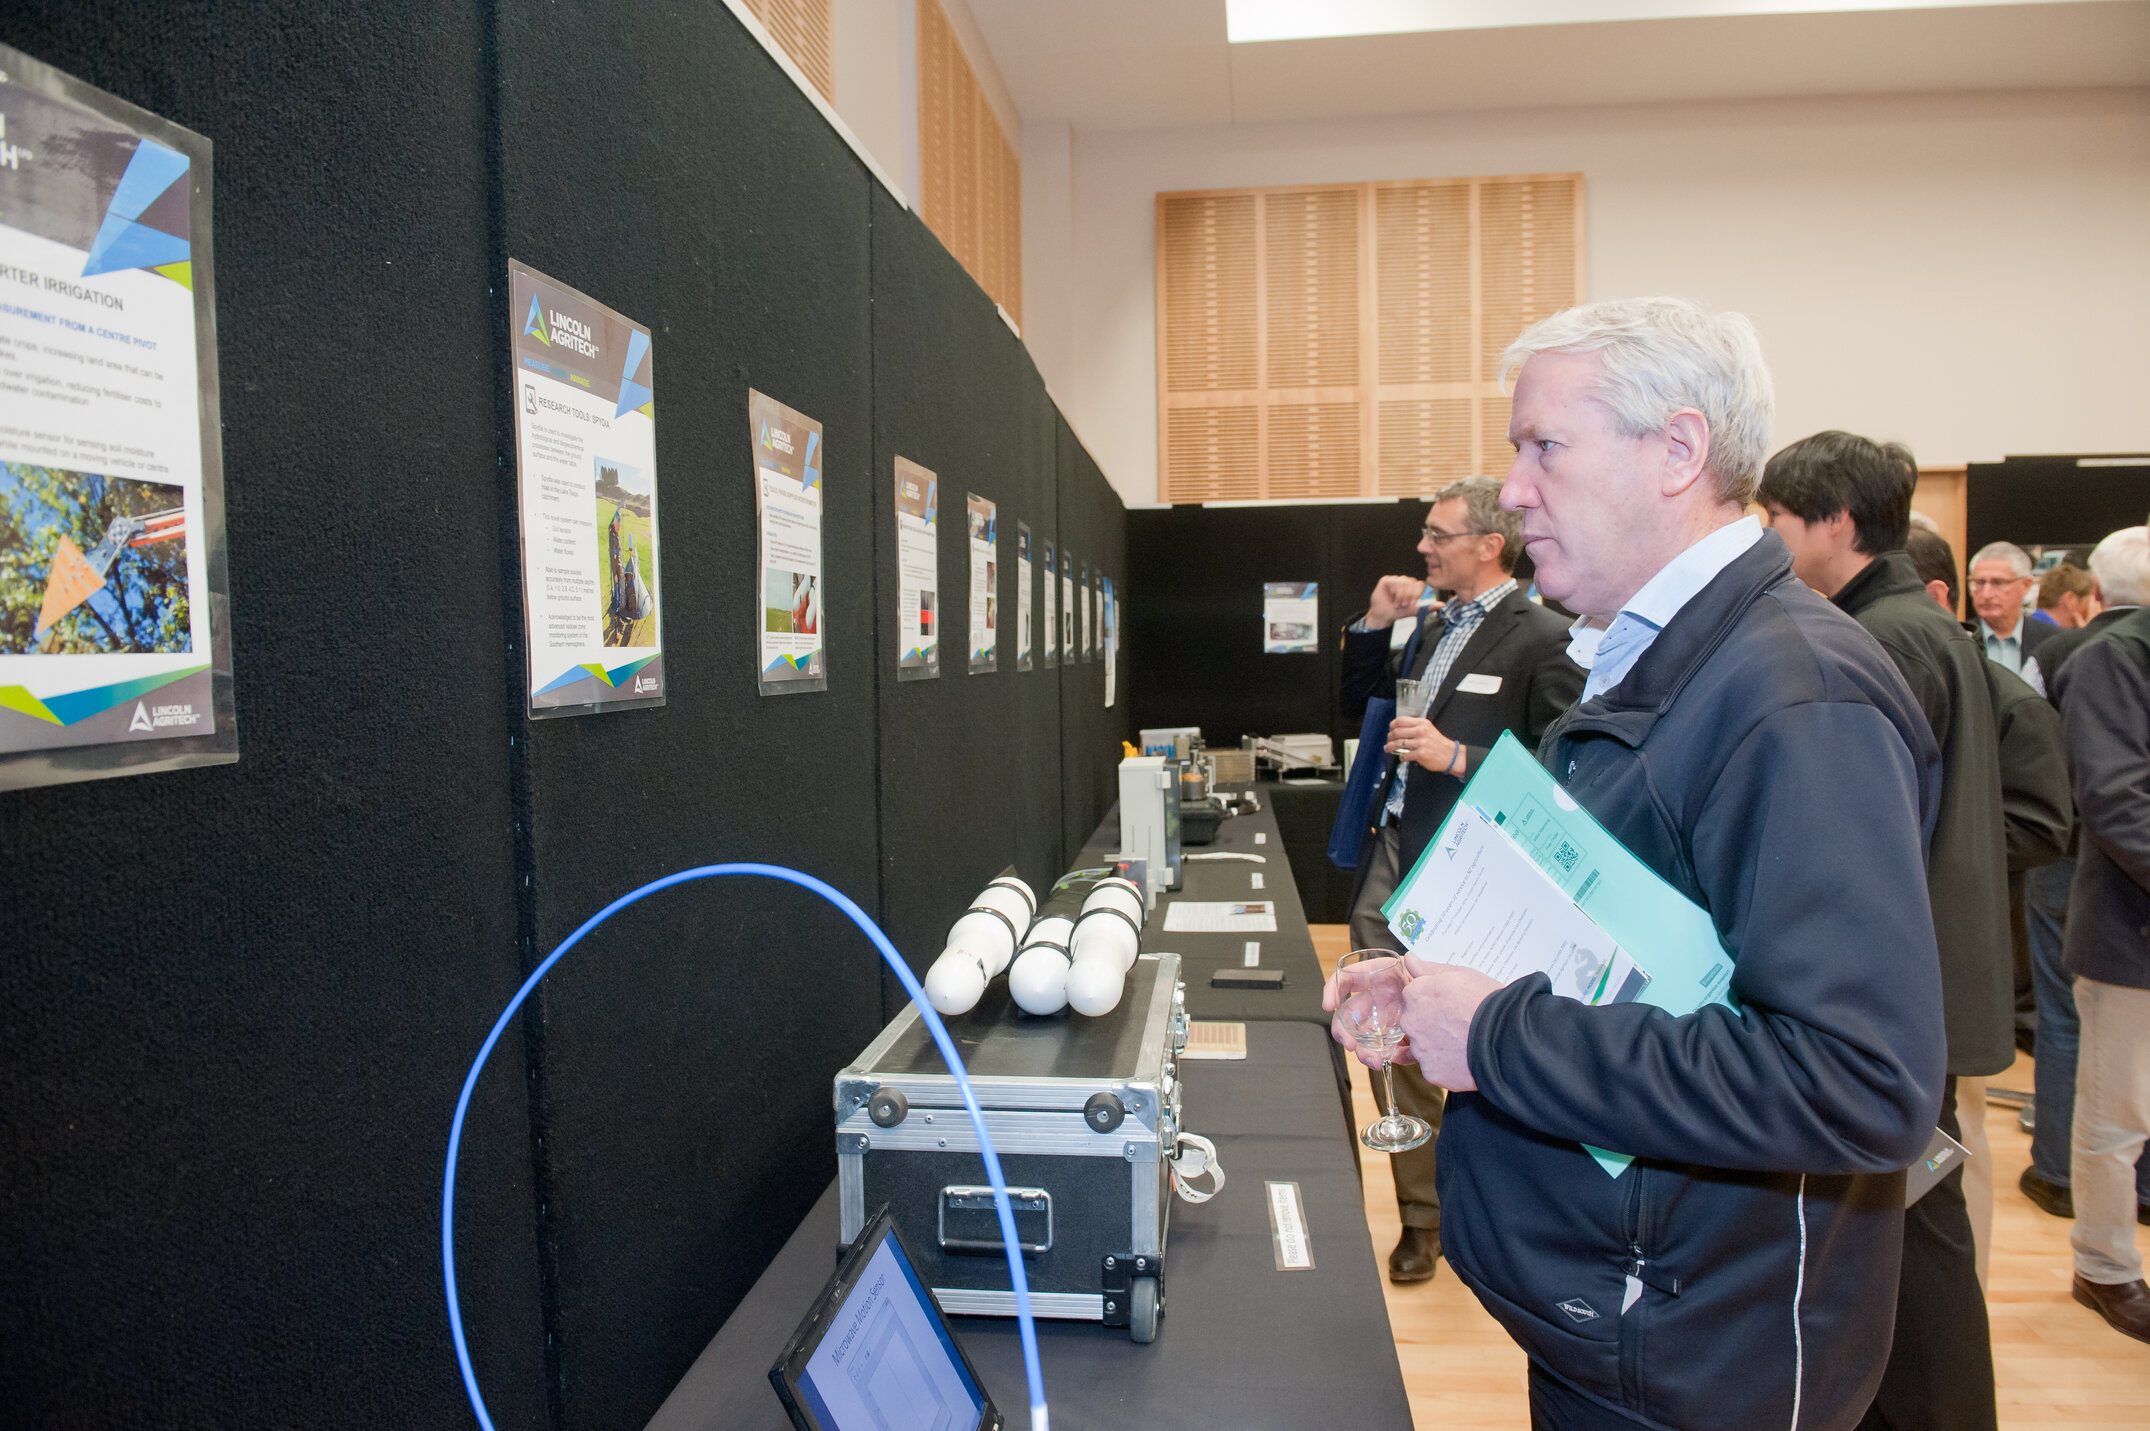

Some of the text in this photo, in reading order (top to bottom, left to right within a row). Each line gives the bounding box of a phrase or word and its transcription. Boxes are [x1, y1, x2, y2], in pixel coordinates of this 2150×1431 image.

[44, 276, 124, 311] IRRIGATION
[59, 317, 86, 332] FROM
[88, 326, 94, 335] A
[96, 327, 131, 345] CENTRE
[133, 337, 157, 351] PIVOT
[550, 310, 591, 342] LINCOLN
[539, 397, 571, 415] RESEARCH
[592, 415, 611, 429] SPYDIA
[34, 431, 61, 443] sensor
[64, 434, 74, 445] for
[124, 446, 154, 458] moisture
[153, 704, 192, 716] LINCOLN
[153, 715, 196, 727] AGRITECH
[1451, 821, 1465, 844] LINCOLN
[1402, 913, 1417, 935] 50
[1285, 1233, 1296, 1244] do
[831, 1273, 886, 1367] Microwave Motion Sensor
